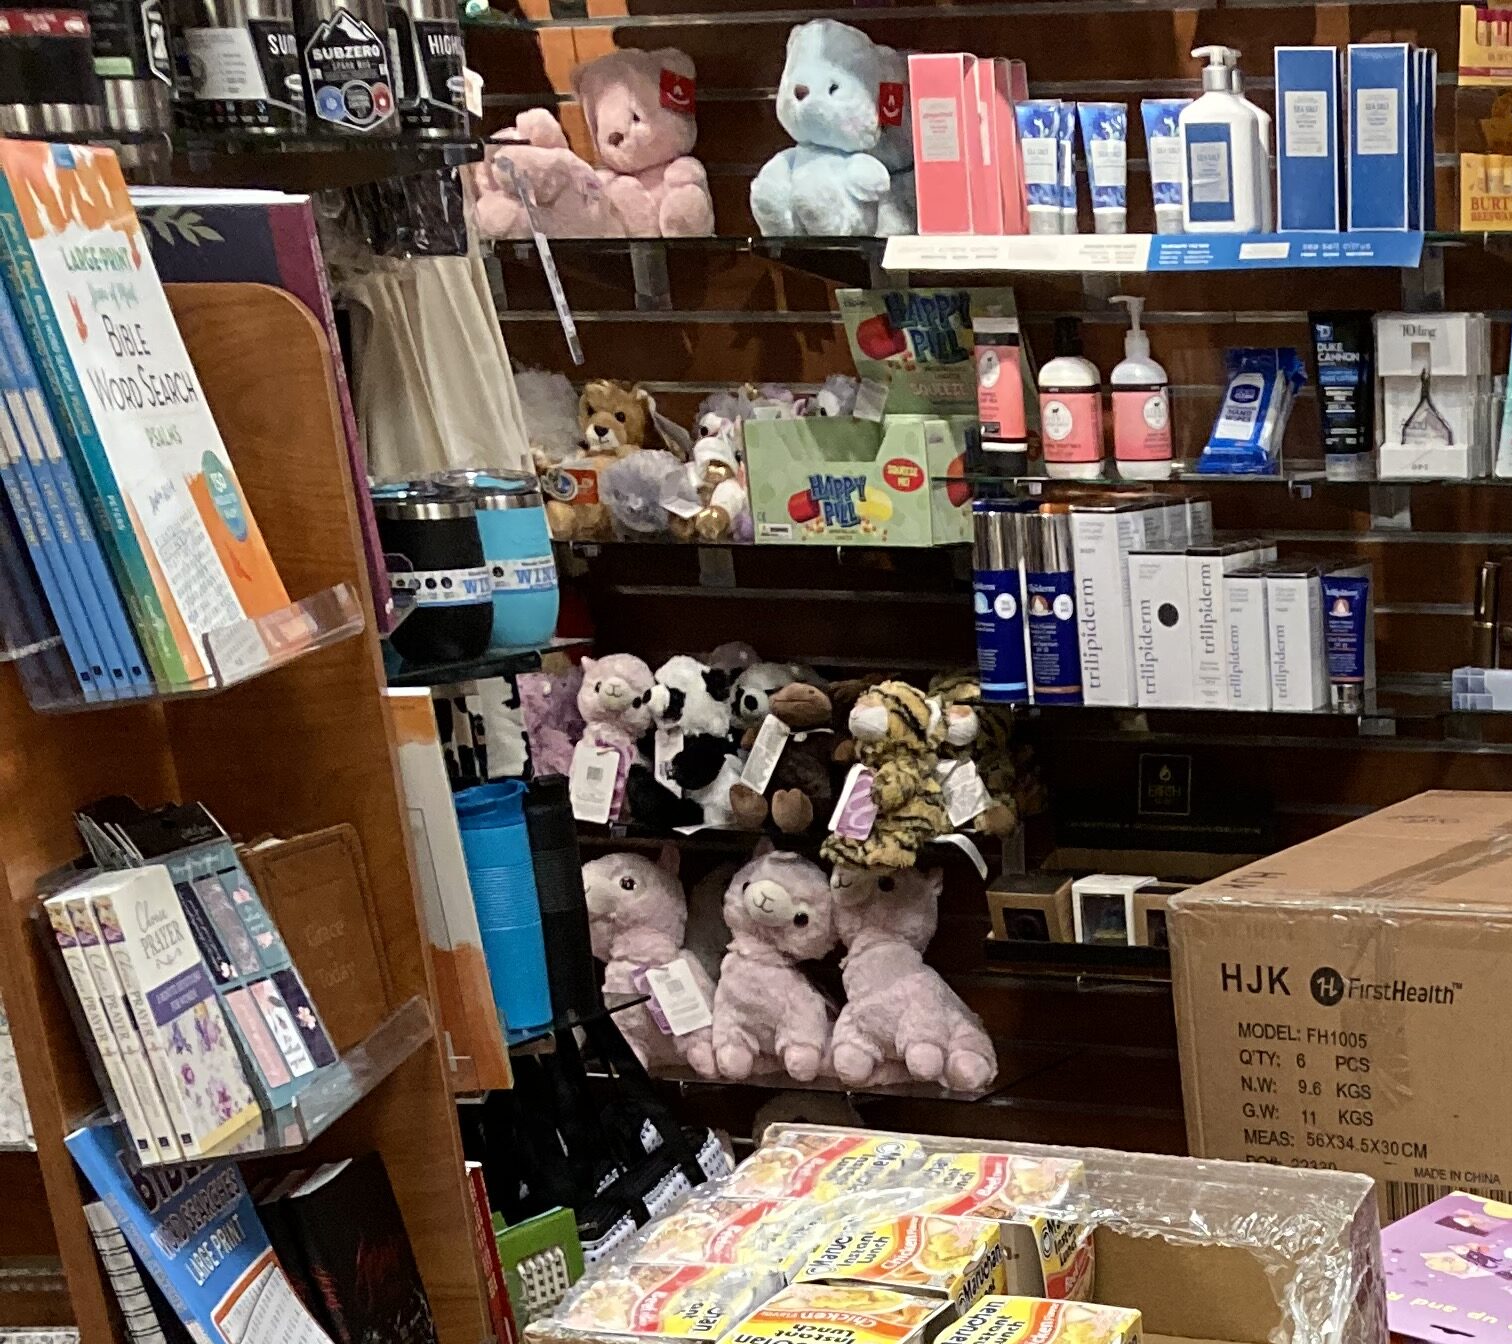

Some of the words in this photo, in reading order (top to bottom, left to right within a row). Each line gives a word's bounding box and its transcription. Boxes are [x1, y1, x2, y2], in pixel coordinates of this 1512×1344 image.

[313, 44, 380, 60] SUBZERO
[102, 314, 151, 357] BIBLE
[1317, 343, 1343, 352] DUKE
[1318, 352, 1360, 363] CANNON
[87, 367, 143, 411] WORD
[138, 363, 199, 407] SEARCH
[809, 474, 867, 501] HAPPY
[1221, 962, 1291, 996] HJK
[1238, 1022, 1301, 1042] MODEL:
[1307, 1028, 1368, 1048] FH1005
[1296, 1053, 1306, 1068] 6
[1335, 1056, 1370, 1073] PCS
[1298, 1079, 1322, 1096] 9.6
[1336, 1083, 1372, 1100] KGS
[1302, 1110, 1317, 1125] 11
[1338, 1110, 1374, 1127] KGS
[1244, 1128, 1295, 1148] MEAS:
[1414, 1168, 1447, 1181] MADE
[1450, 1169, 1462, 1181] IN
[1465, 1171, 1500, 1184] CHINA
[1410, 1298, 1458, 1313] and
[800, 1312, 877, 1328] Chicken
[1467, 1311, 1498, 1326] up
[793, 1323, 856, 1338] Lunch
